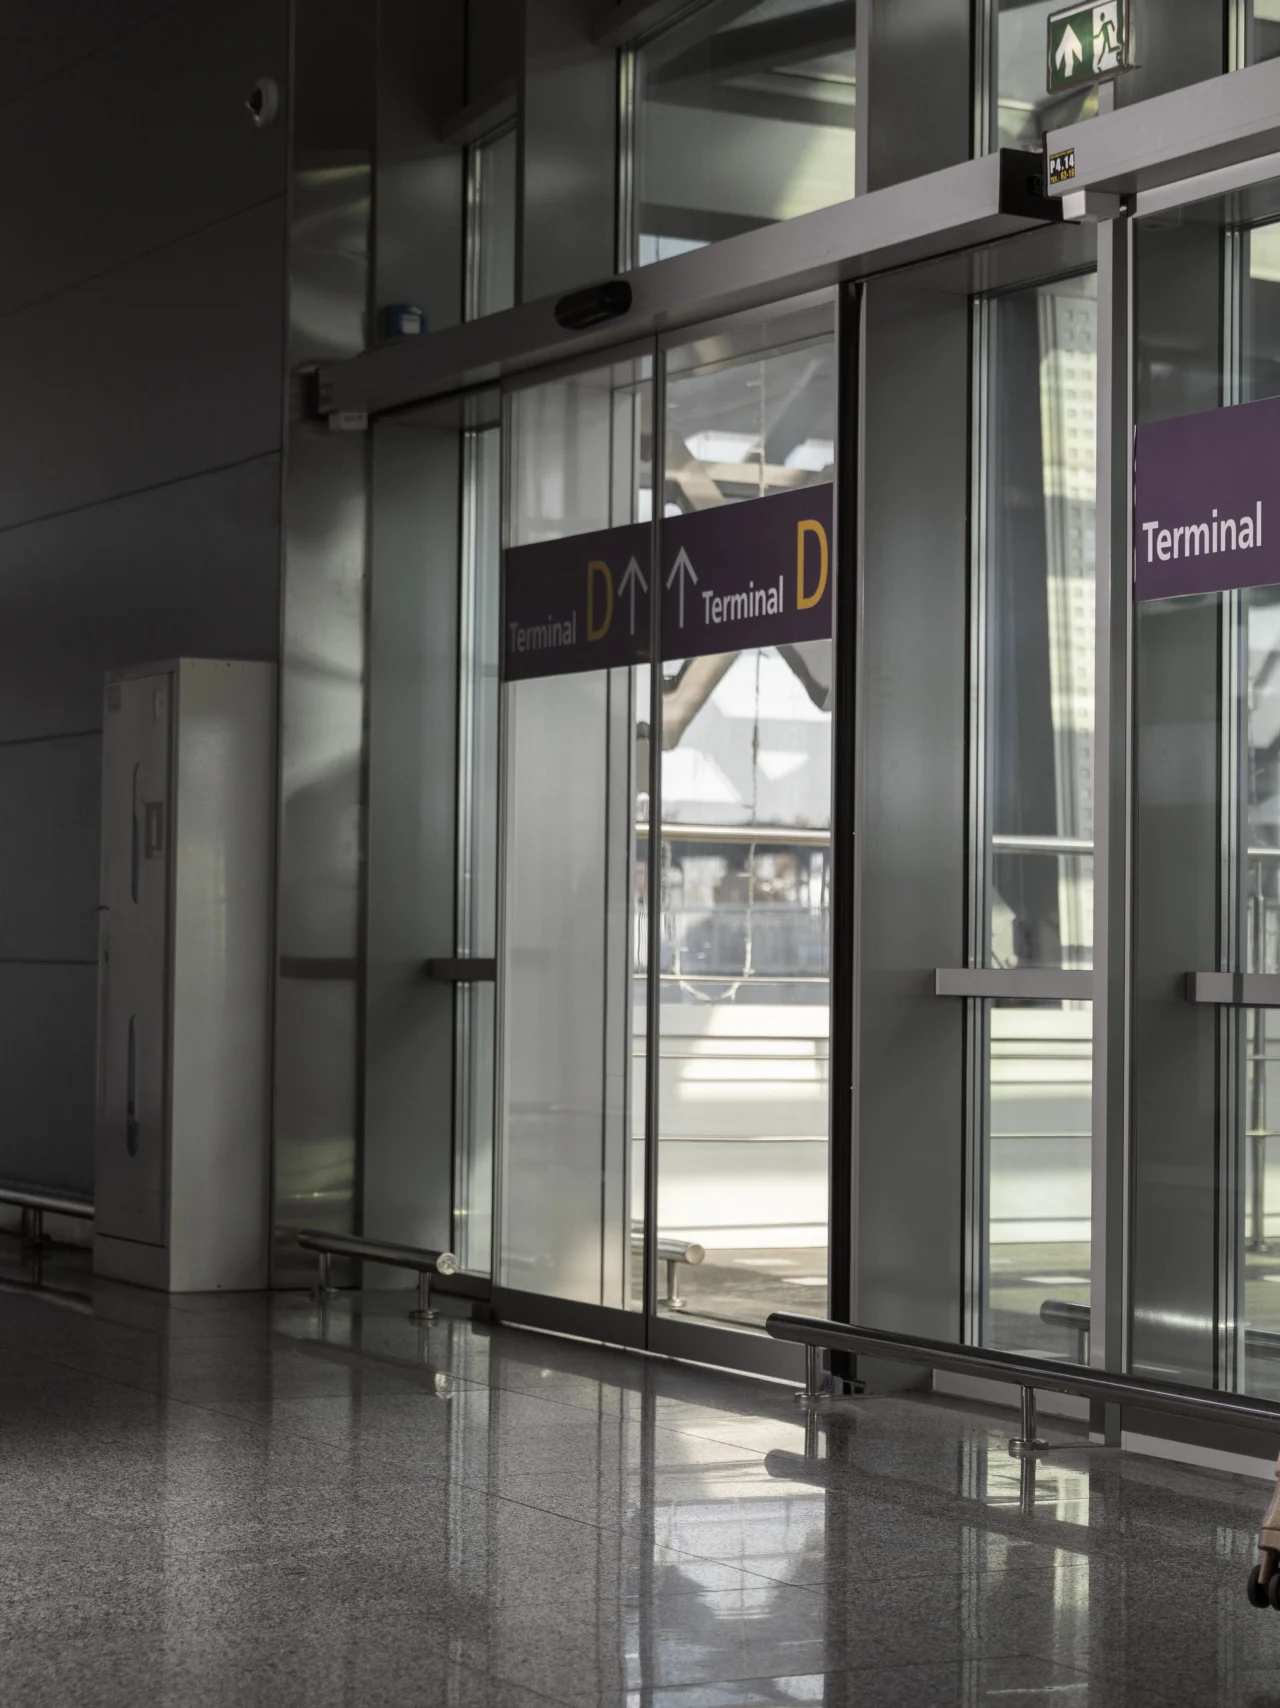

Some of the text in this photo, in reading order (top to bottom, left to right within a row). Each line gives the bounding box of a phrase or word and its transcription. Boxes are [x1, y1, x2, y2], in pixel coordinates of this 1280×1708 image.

[1050, 153, 1075, 174] P4.14
[1142, 500, 1262, 563] Terminal
[508, 560, 614, 652] Terminal D
[702, 518, 829, 625] Terminal D
